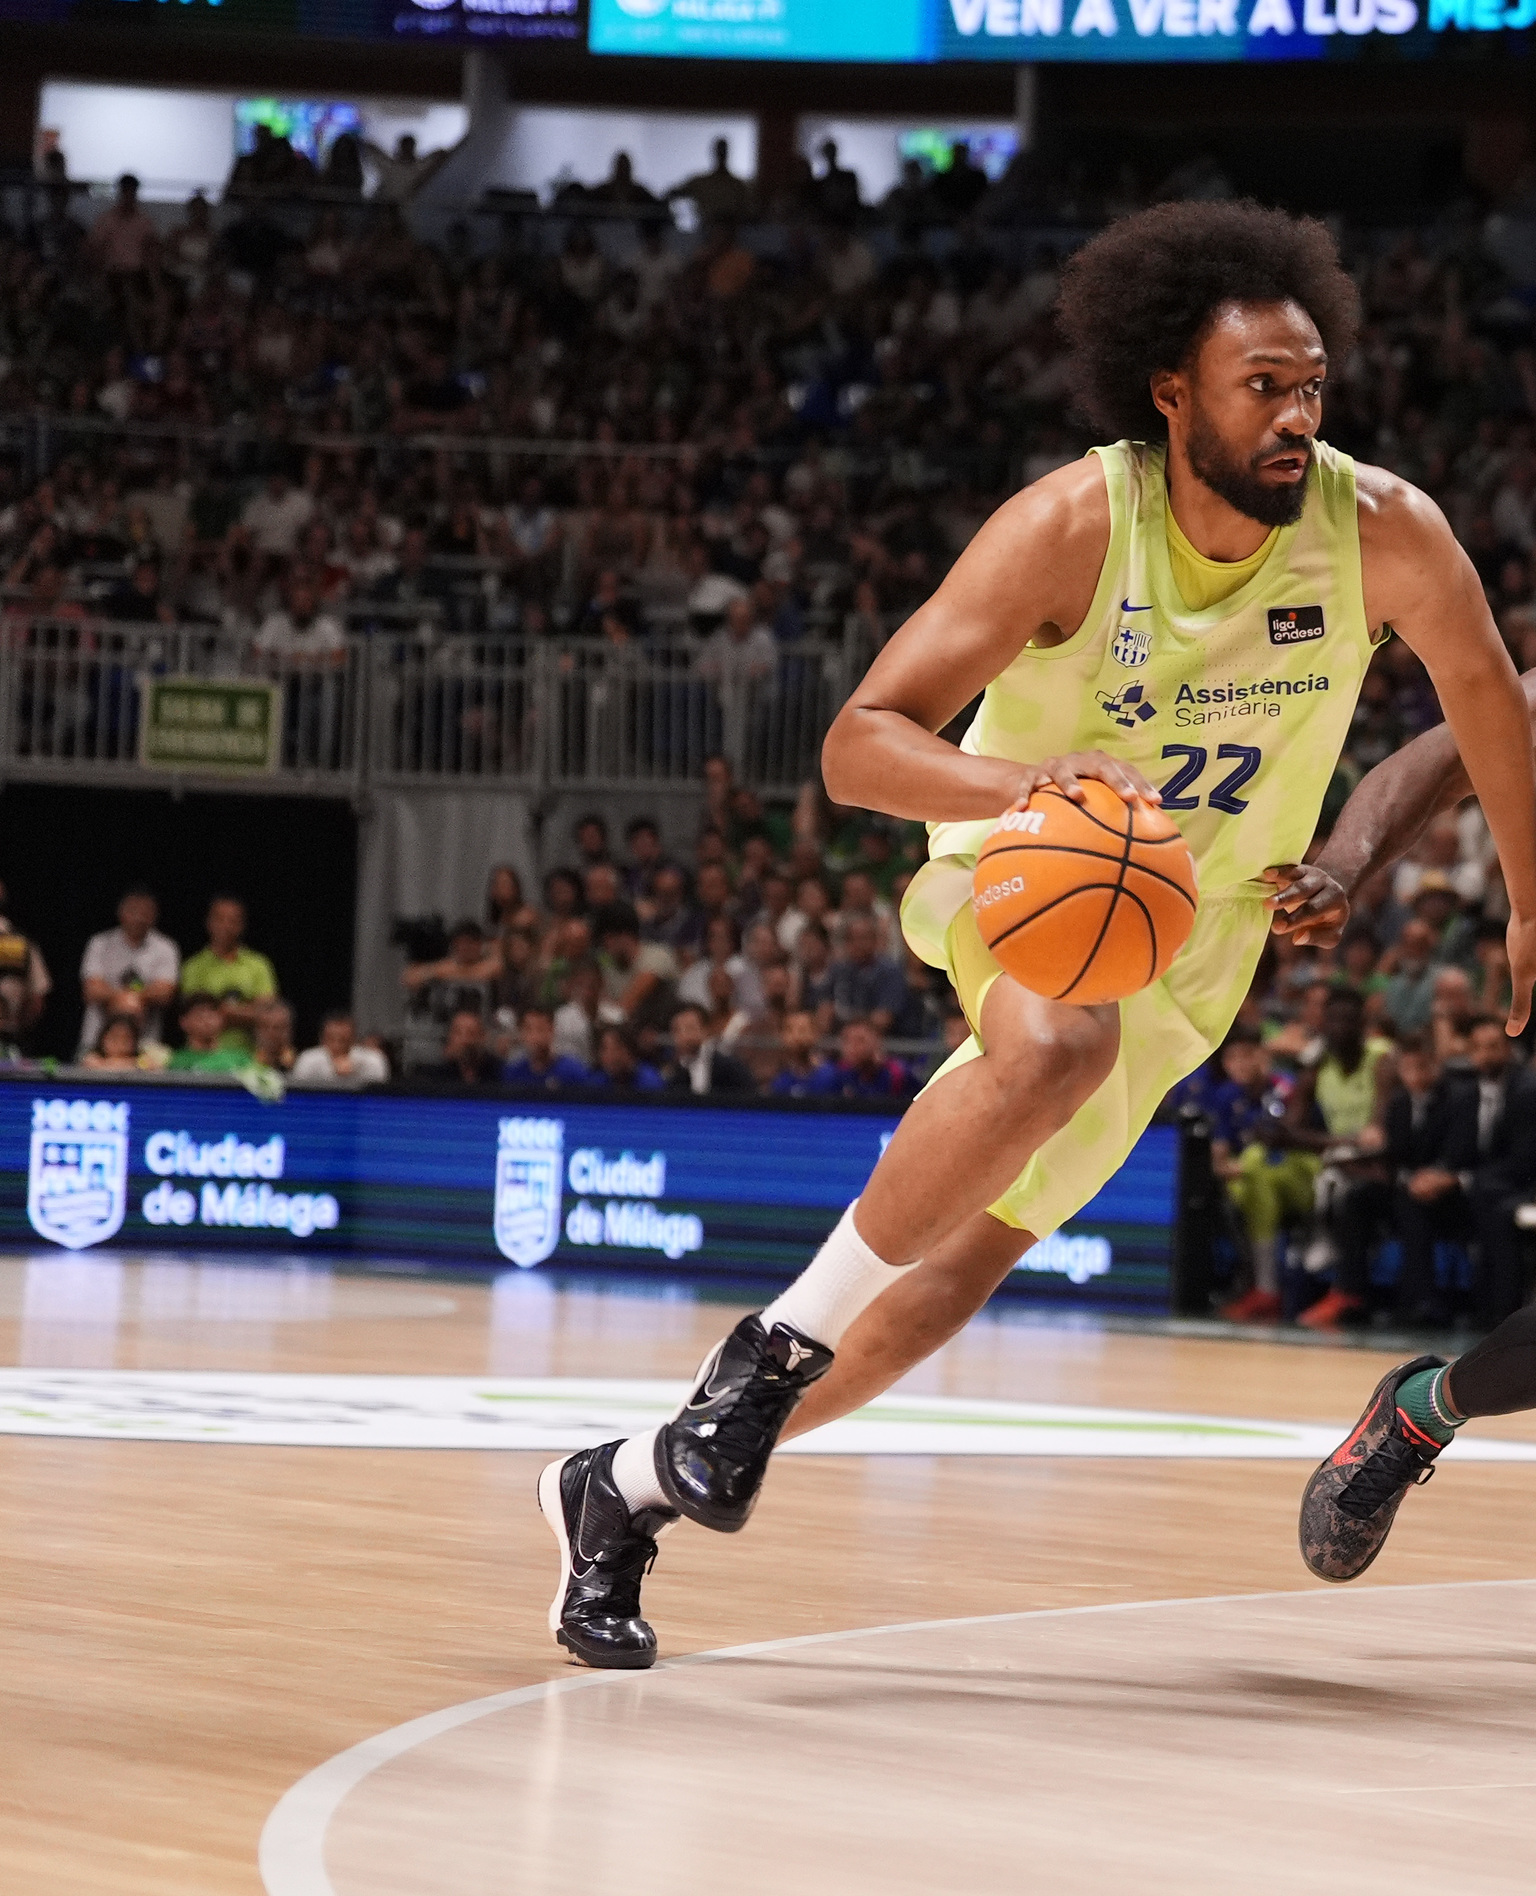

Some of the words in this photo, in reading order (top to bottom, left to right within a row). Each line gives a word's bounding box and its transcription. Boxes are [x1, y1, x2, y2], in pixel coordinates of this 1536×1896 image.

[949, 0, 1061, 36] VEN
[1070, 0, 1119, 37] A
[1127, 0, 1241, 36] VER
[1247, 0, 1296, 36] A
[1302, 0, 1419, 35] LOS
[1272, 619, 1296, 632] liga
[1274, 627, 1323, 642] endesa
[1174, 674, 1330, 705] Assistència
[1174, 698, 1281, 728] Sanitària
[1160, 743, 1263, 816] 22
[145, 1130, 285, 1178] Ciudad
[568, 1147, 666, 1198] Ciudad
[142, 1180, 196, 1226] de
[200, 1181, 339, 1237] Málaga
[566, 1199, 603, 1245] de
[604, 1200, 703, 1260] Málaga
